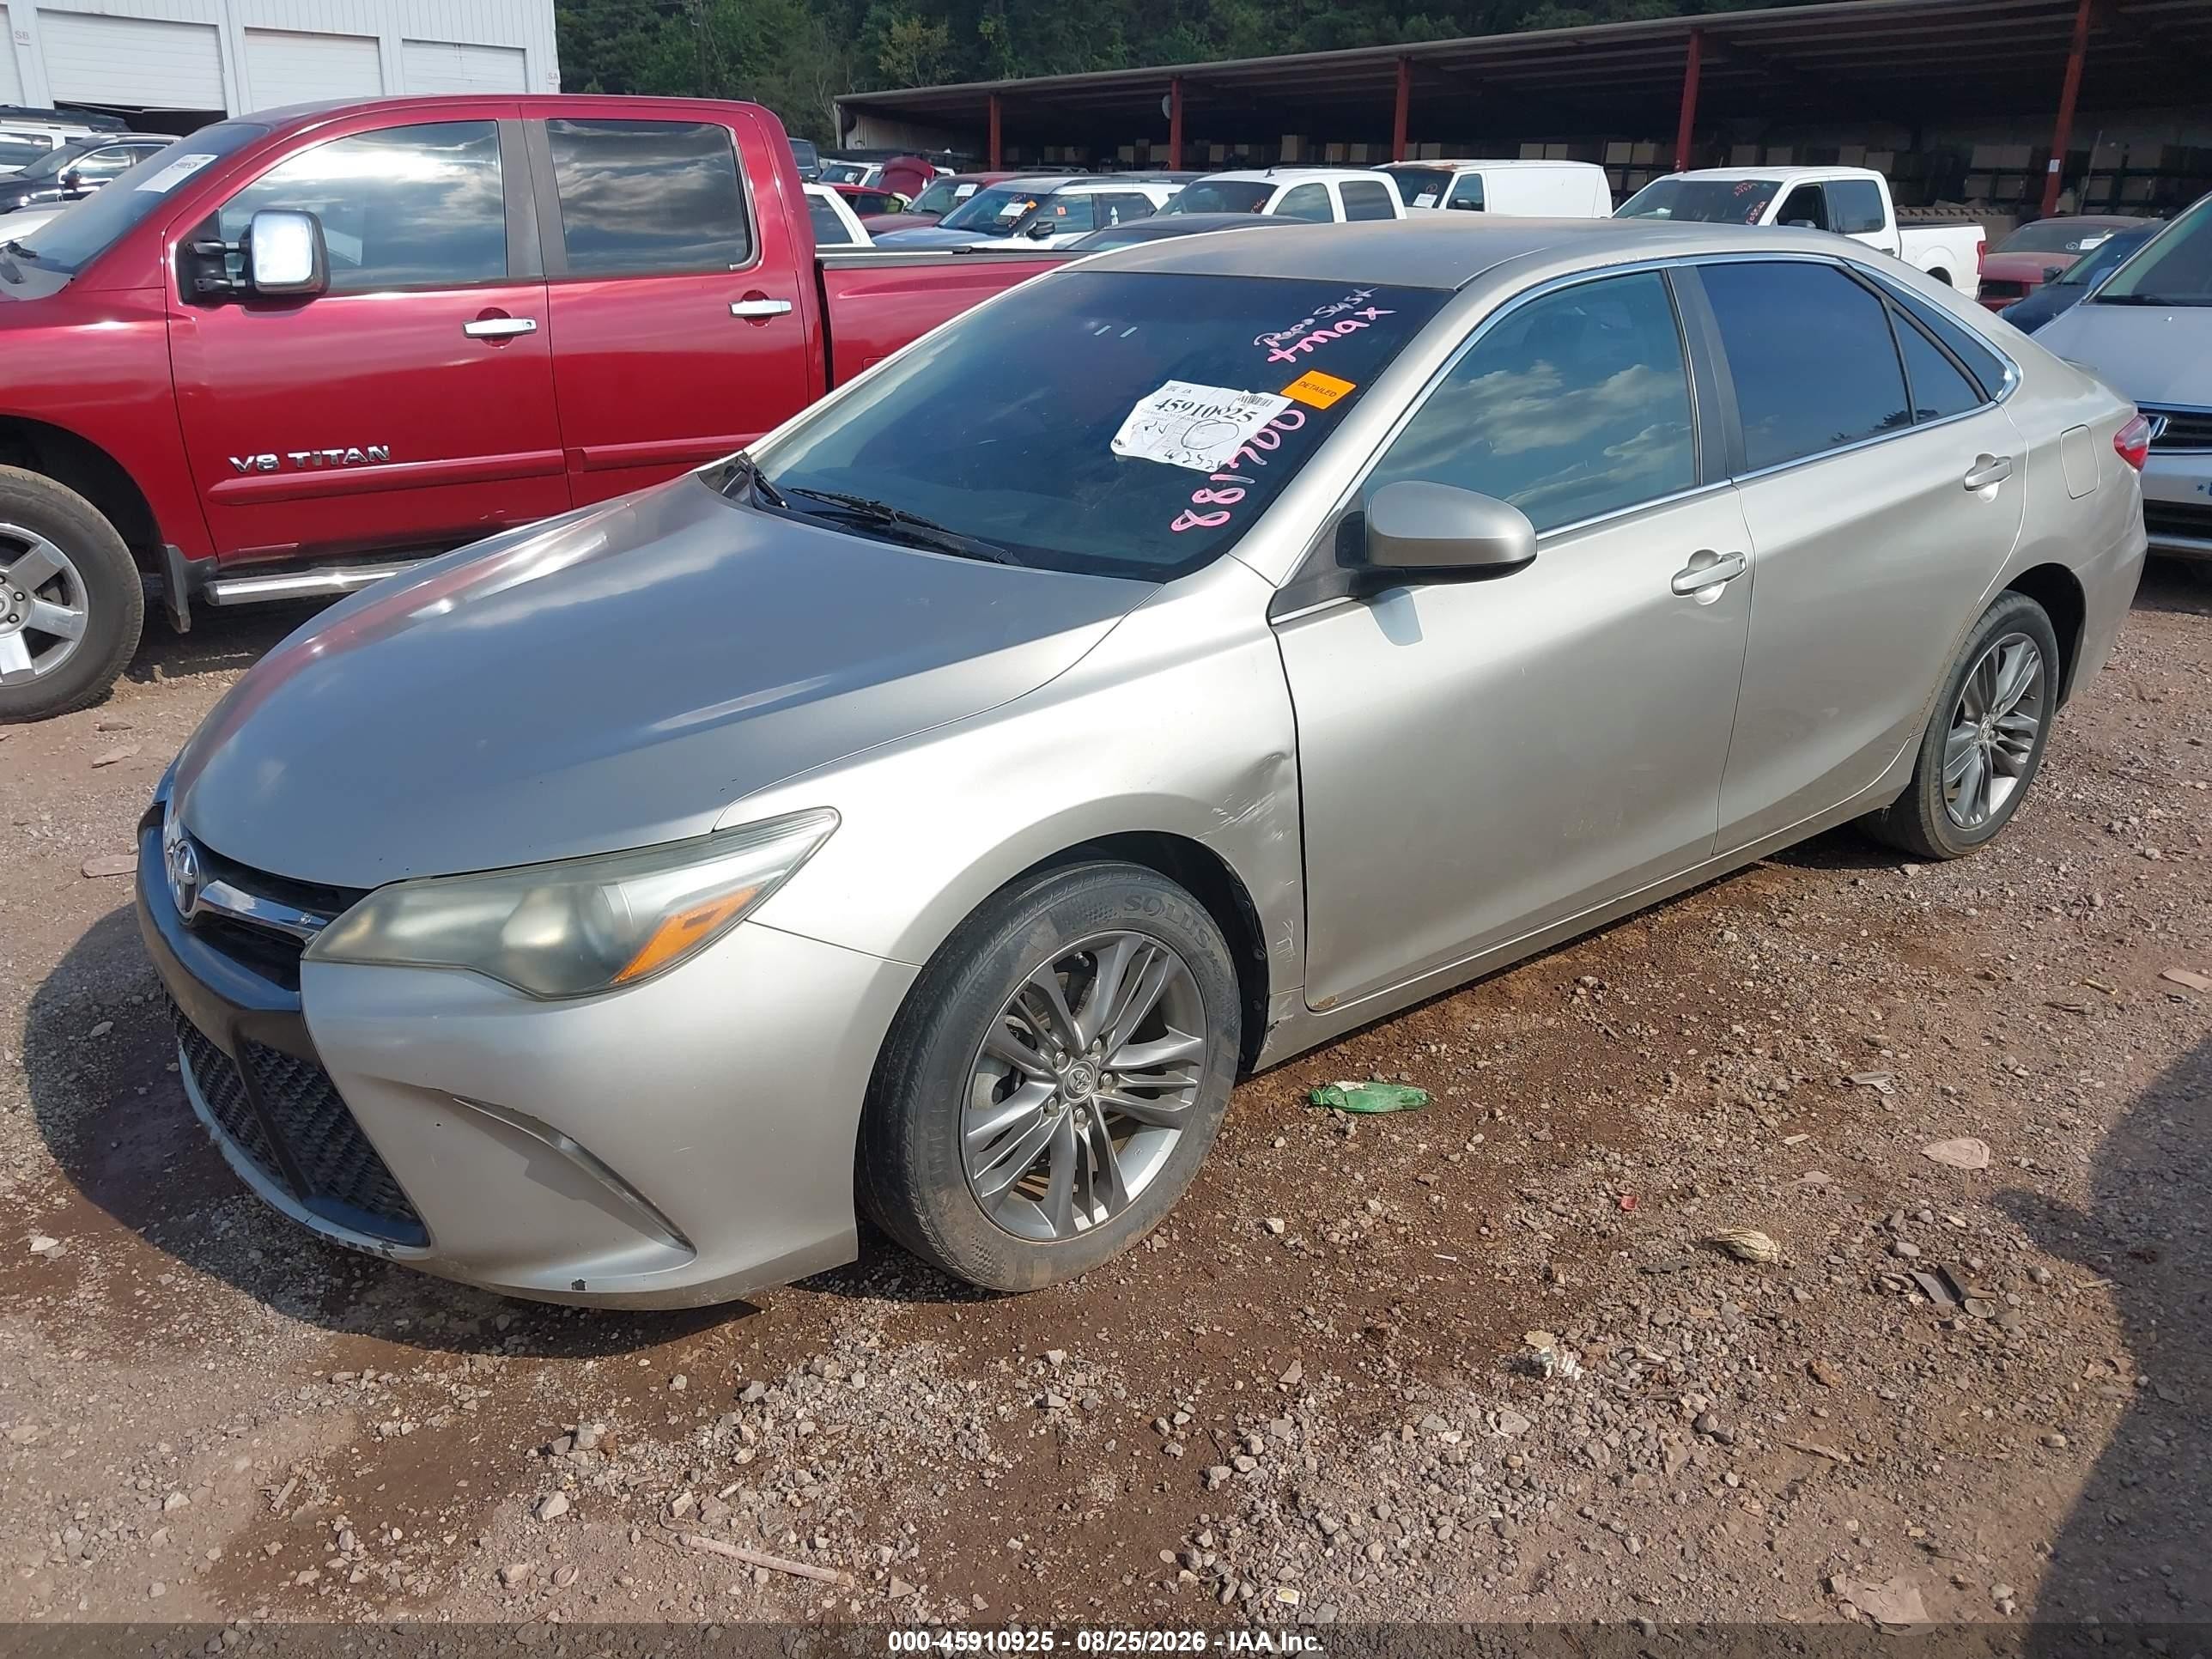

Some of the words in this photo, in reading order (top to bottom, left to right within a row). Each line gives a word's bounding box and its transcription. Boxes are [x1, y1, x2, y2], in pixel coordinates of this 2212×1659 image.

[1297, 380, 1338, 398] DETAILED
[228, 453, 280, 473] V8
[287, 445, 391, 468] TITAN
[1123, 894, 1211, 949] SOLUS
